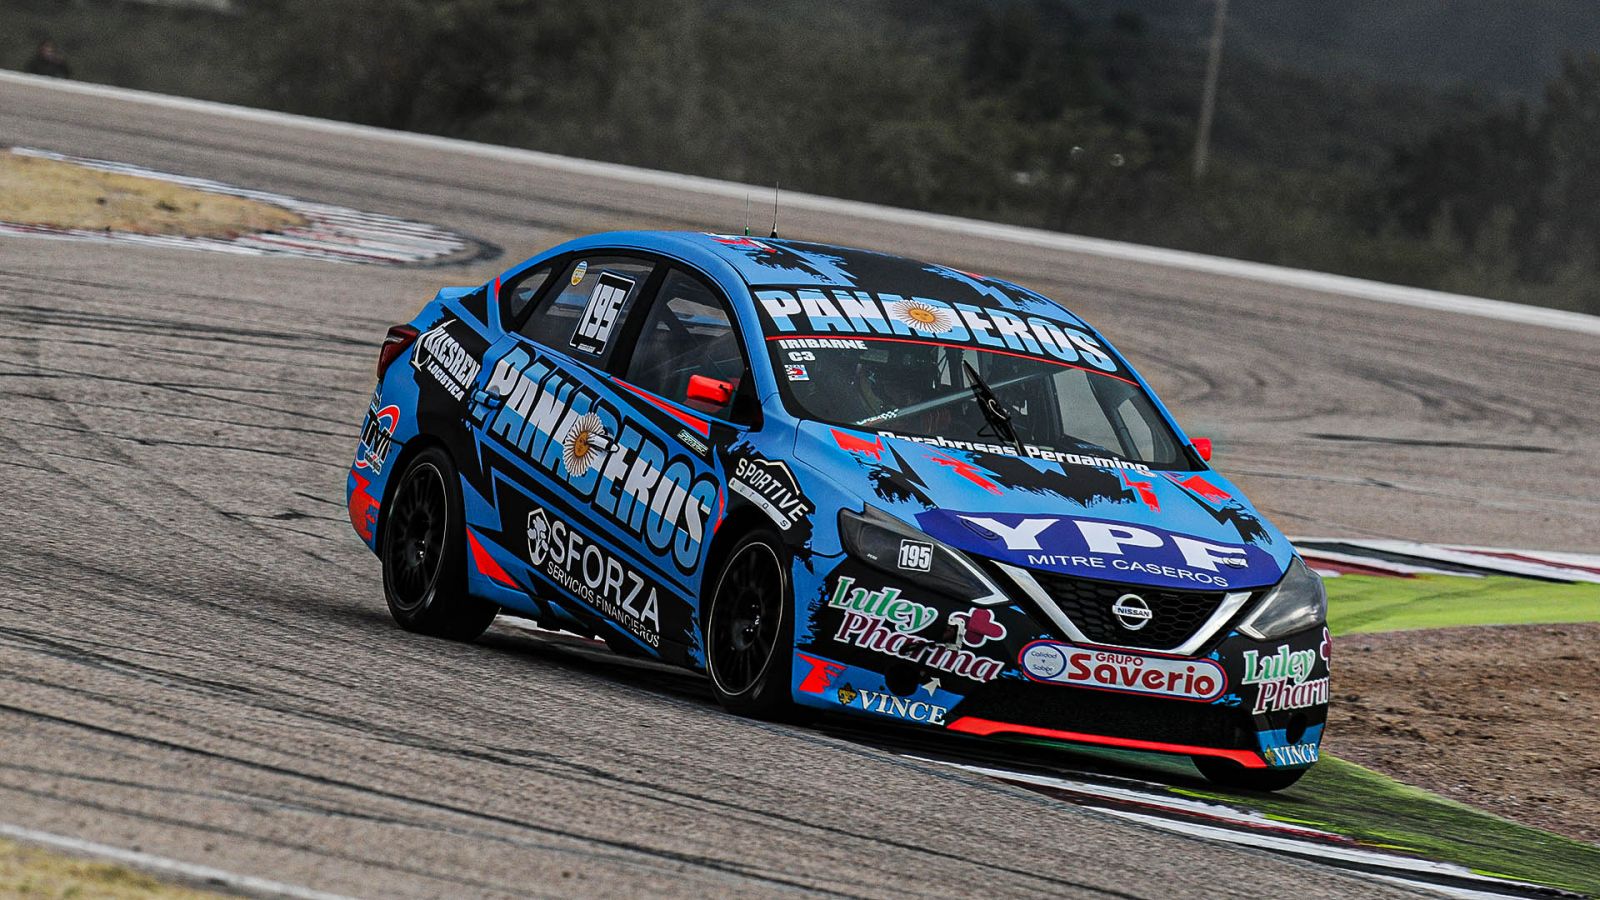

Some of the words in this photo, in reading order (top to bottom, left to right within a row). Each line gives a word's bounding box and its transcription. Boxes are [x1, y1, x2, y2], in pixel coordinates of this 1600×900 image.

[578, 283, 627, 343] 195
[754, 288, 1118, 373] PANADEROS
[778, 338, 869, 351] IRIBARNE
[787, 351, 816, 362] C3
[426, 360, 466, 402] LOGISTICA
[472, 346, 717, 569] PANADEROS
[1024, 445, 1150, 471] Pergamino
[735, 457, 809, 523] SPORTIVE
[901, 544, 931, 569] 195
[956, 514, 1249, 574] YPF
[549, 520, 660, 633] SFORZA
[1027, 554, 1104, 569] MITRE
[1111, 558, 1228, 588] CASEROS
[547, 561, 594, 603] SERVICIOS
[595, 595, 660, 648] FINANCIEROS
[828, 576, 938, 634] Luley
[1117, 607, 1150, 617] NISSAN
[834, 611, 1005, 683] Pharma
[1095, 653, 1144, 667] GRUPO
[1241, 644, 1316, 685] Luley
[1068, 653, 1215, 696] Saverio
[858, 689, 947, 726] VINCE
[1273, 743, 1319, 766] VINCE
